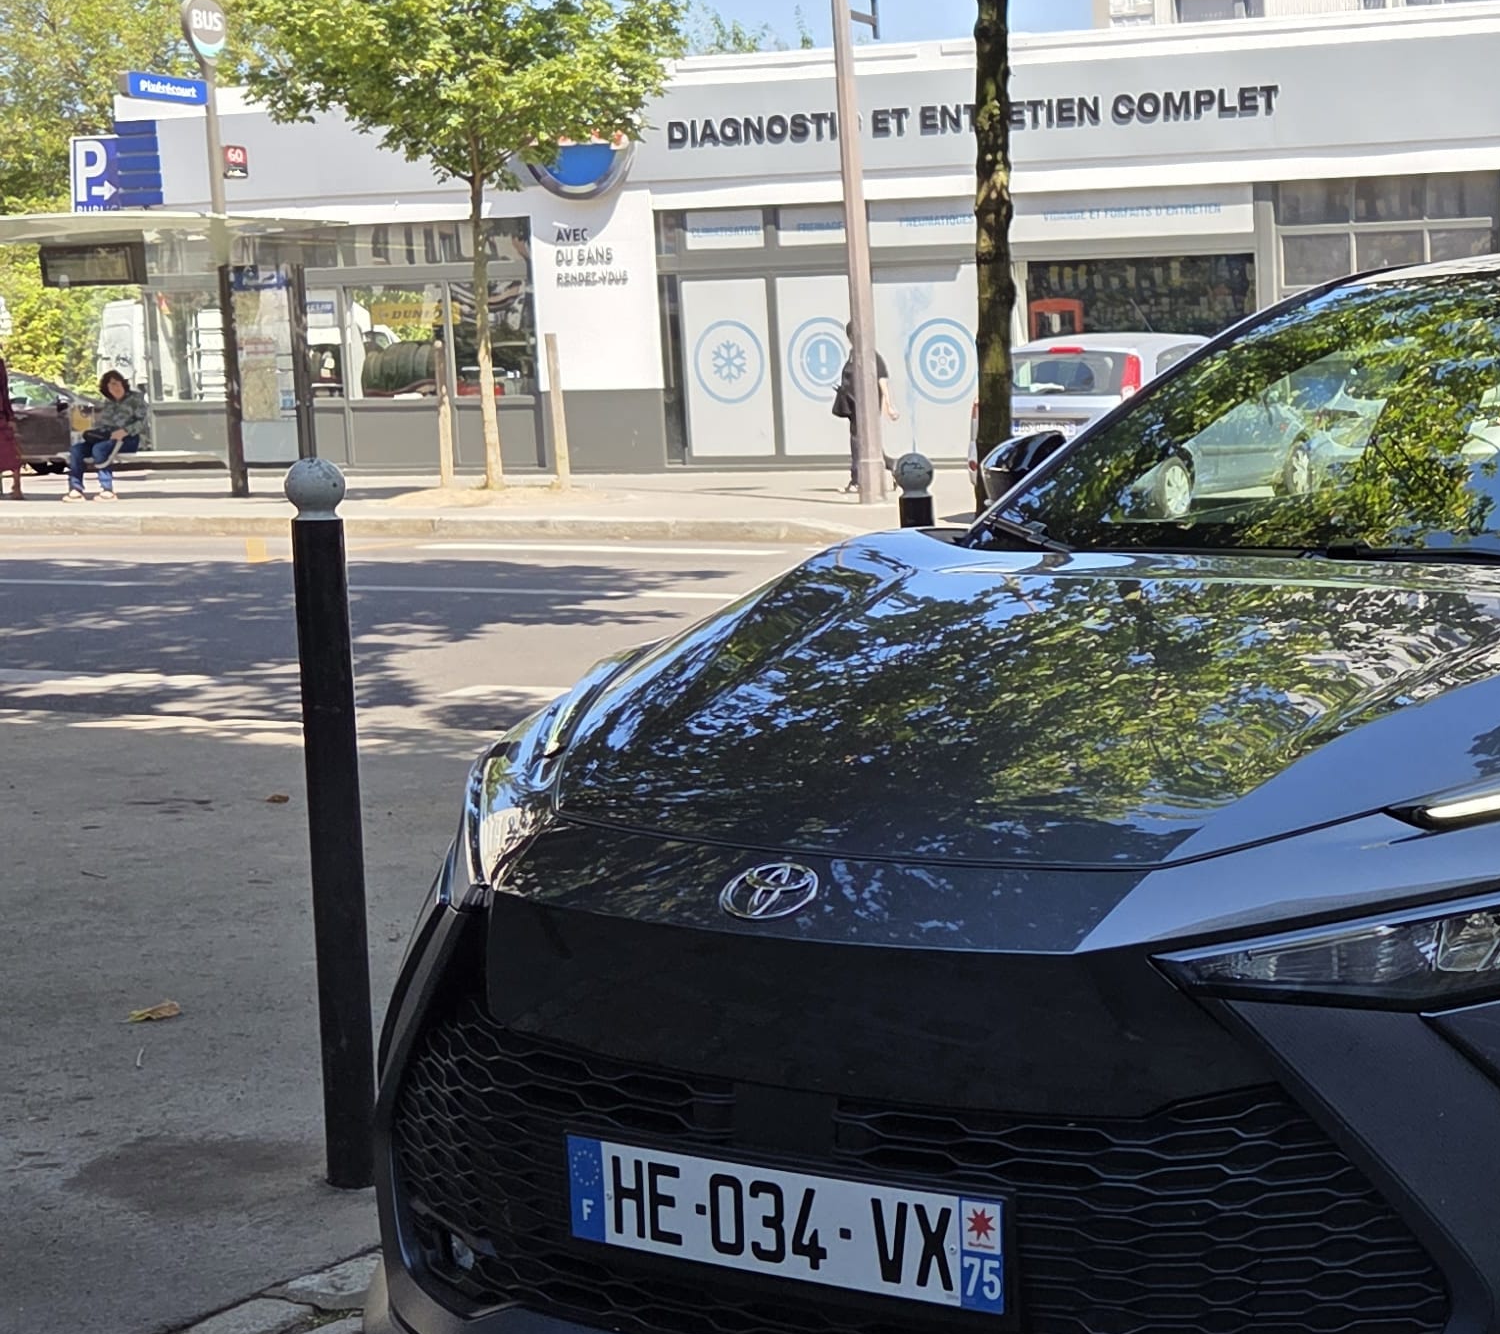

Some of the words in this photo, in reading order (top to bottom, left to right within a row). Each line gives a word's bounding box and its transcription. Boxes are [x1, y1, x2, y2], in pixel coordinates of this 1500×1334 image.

[192, 9, 222, 31] BUS
[668, 110, 862, 149] DIAGNOSTI
[872, 108, 910, 138] ET
[919, 94, 1100, 136] ENTETIEN
[1112, 85, 1279, 125] COMPLET
[227, 147, 244, 163] 60
[75, 140, 107, 202] P
[556, 228, 588, 242] AVEC
[577, 247, 613, 265] SANS
[556, 270, 628, 287] RENDEZ-VOUS
[582, 1198, 594, 1221] F
[963, 1255, 1001, 1301] 75
